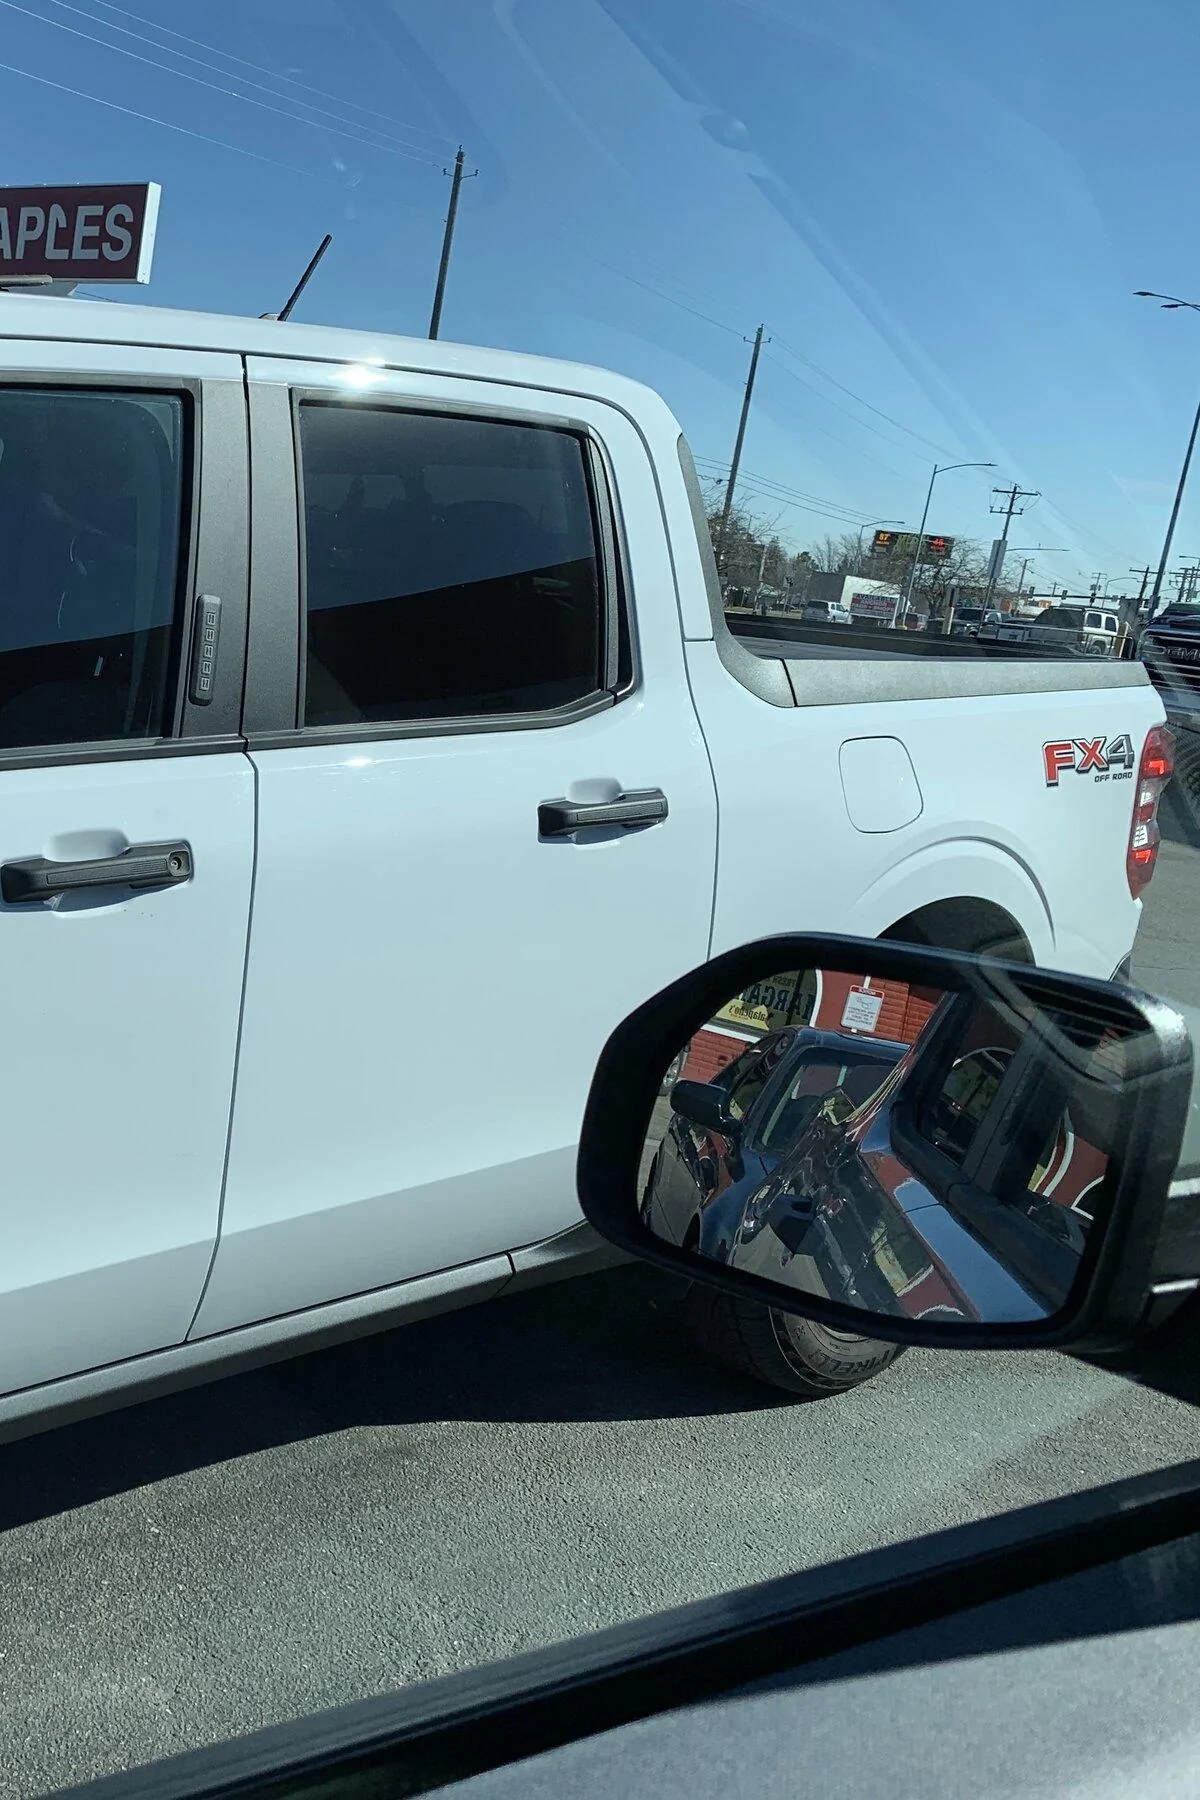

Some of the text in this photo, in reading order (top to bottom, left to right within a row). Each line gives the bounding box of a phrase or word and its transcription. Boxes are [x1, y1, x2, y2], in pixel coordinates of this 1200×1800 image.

[1167, 646, 1200, 660] GM
[1042, 734, 1135, 787] FX4
[1112, 772, 1133, 781] ROAD
